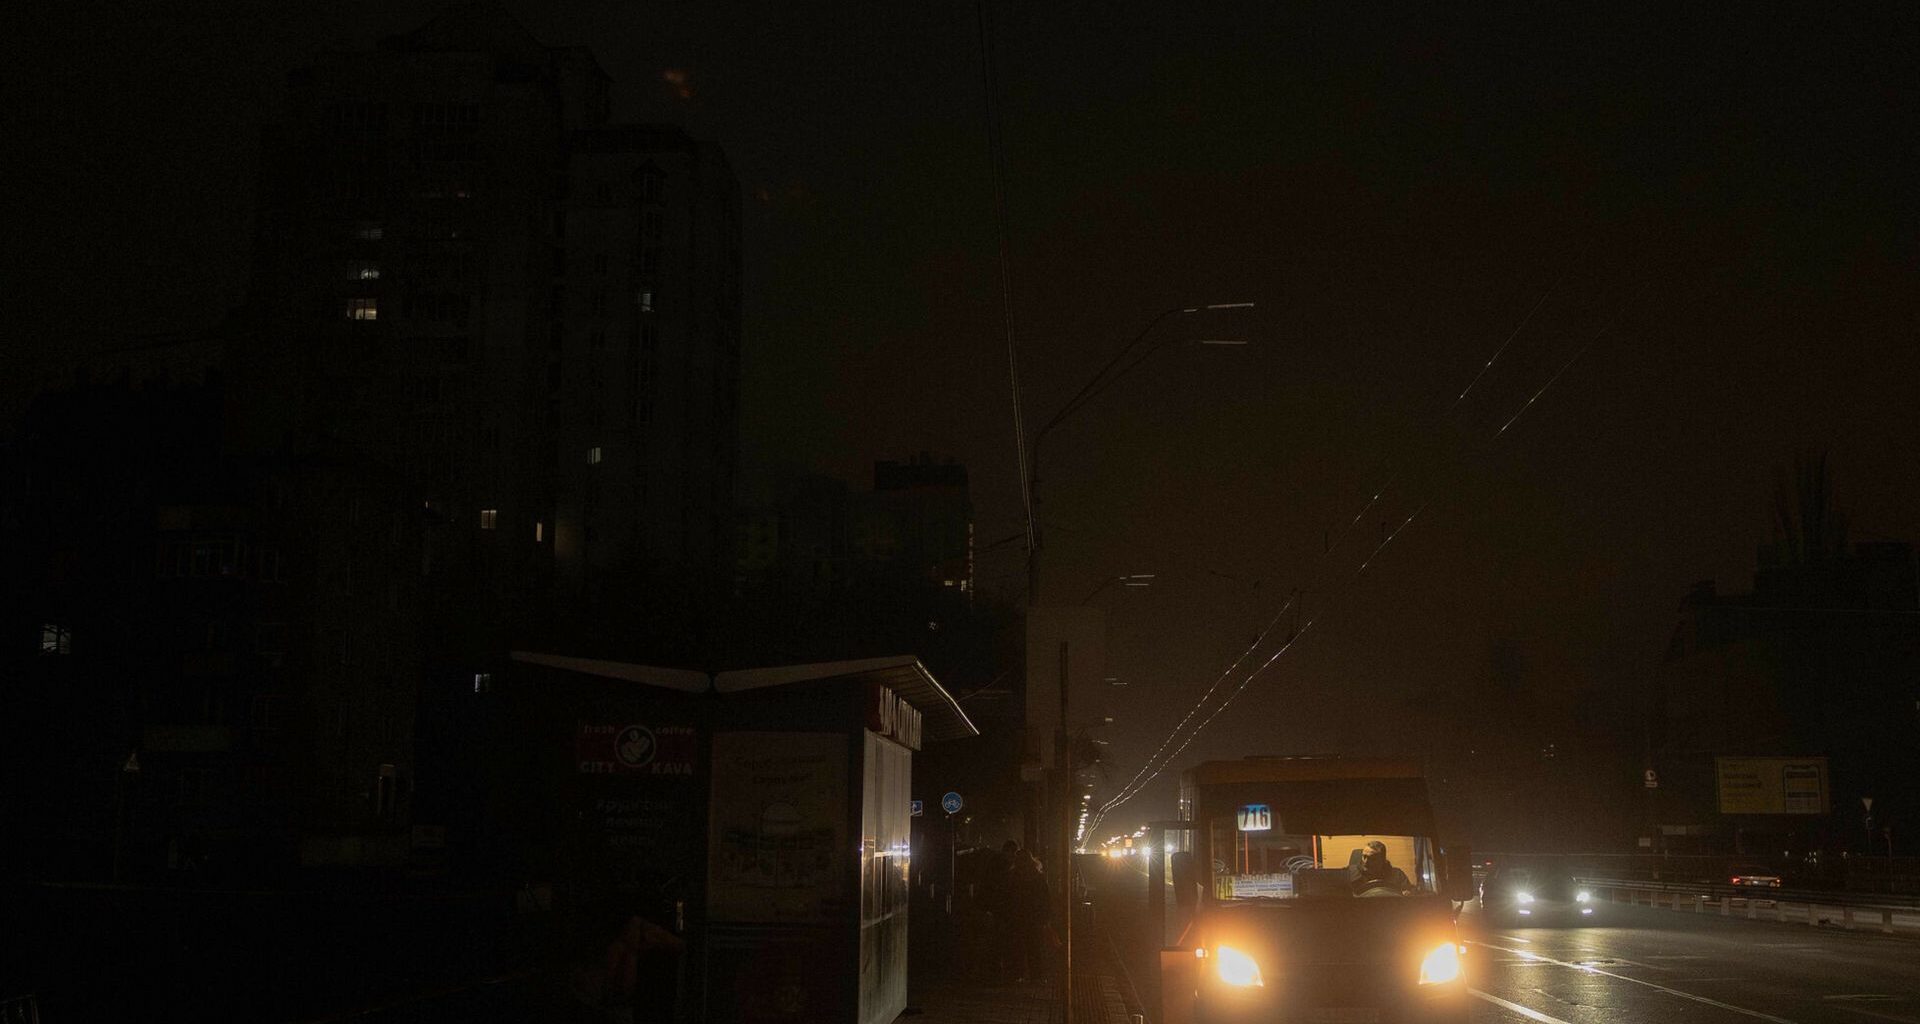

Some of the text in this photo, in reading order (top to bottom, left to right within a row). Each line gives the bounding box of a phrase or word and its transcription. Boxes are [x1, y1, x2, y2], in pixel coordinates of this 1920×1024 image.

[579, 761, 693, 775] CITY KAVA
[1238, 806, 1268, 828] 716
